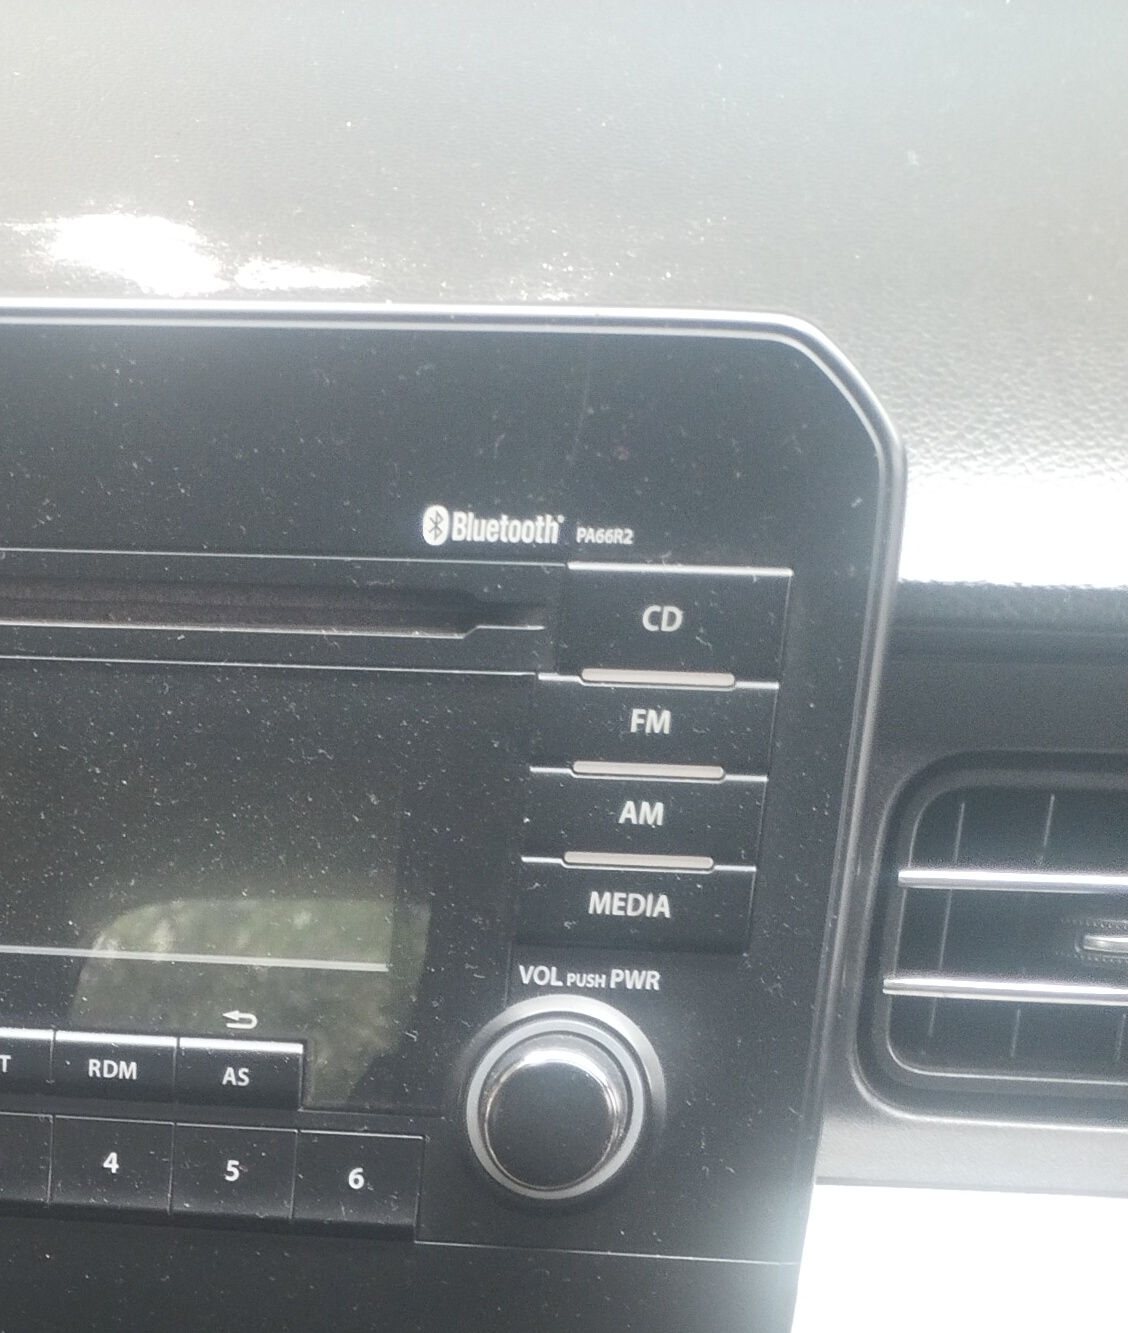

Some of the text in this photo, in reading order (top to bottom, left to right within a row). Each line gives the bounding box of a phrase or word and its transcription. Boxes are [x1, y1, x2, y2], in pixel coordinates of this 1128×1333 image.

[450, 510, 565, 545] Bluetooth
[575, 526, 634, 545] PA66R2
[641, 604, 684, 633] CD
[630, 708, 672, 735] FM
[618, 800, 664, 827] AM
[588, 890, 671, 919] MEDIA
[518, 964, 661, 991] VOL PUSH PWR
[88, 1058, 138, 1080] RDM
[222, 1066, 250, 1087] AS
[102, 1151, 120, 1174] 4
[225, 1159, 240, 1182] 5
[348, 1167, 365, 1190] 6
